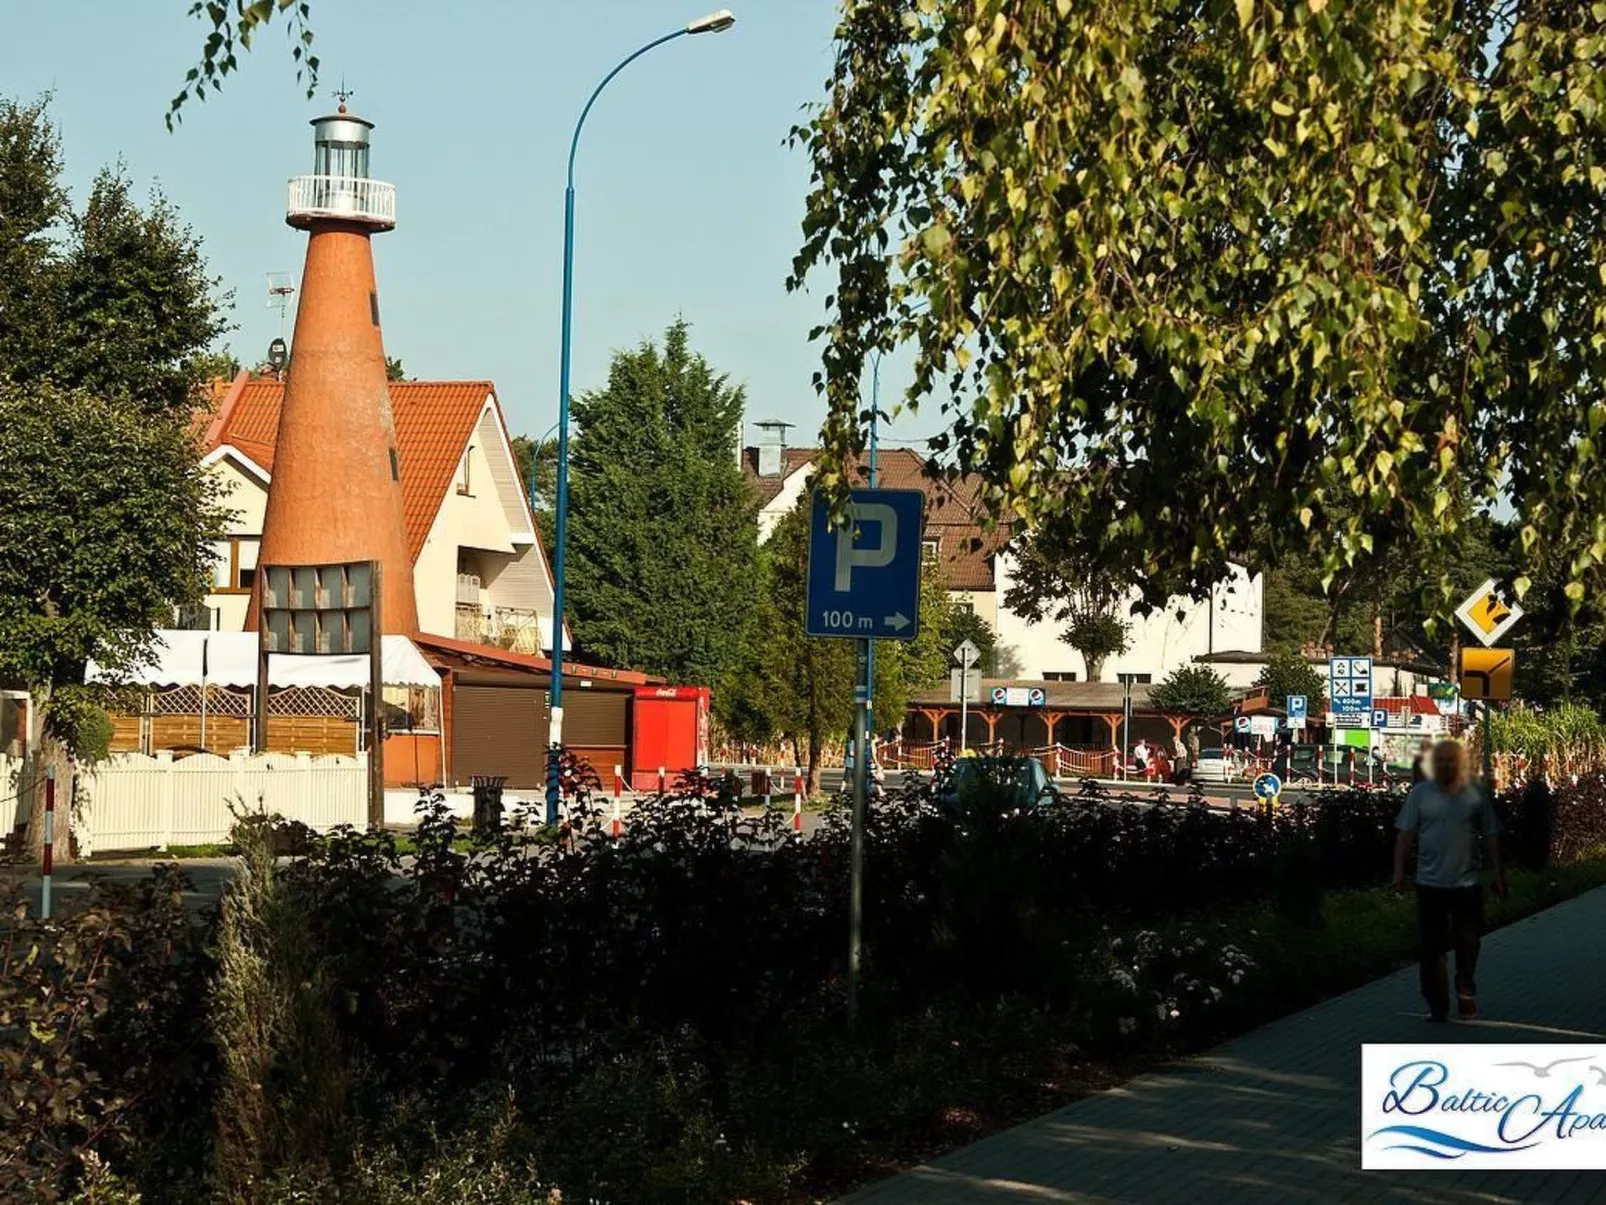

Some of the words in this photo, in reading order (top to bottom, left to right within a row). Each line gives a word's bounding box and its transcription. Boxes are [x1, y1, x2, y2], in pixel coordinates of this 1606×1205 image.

[834, 502, 898, 592] P
[822, 610, 853, 628] 100
[858, 616, 873, 629] m
[1291, 697, 1304, 711] P
[1373, 710, 1385, 725] P
